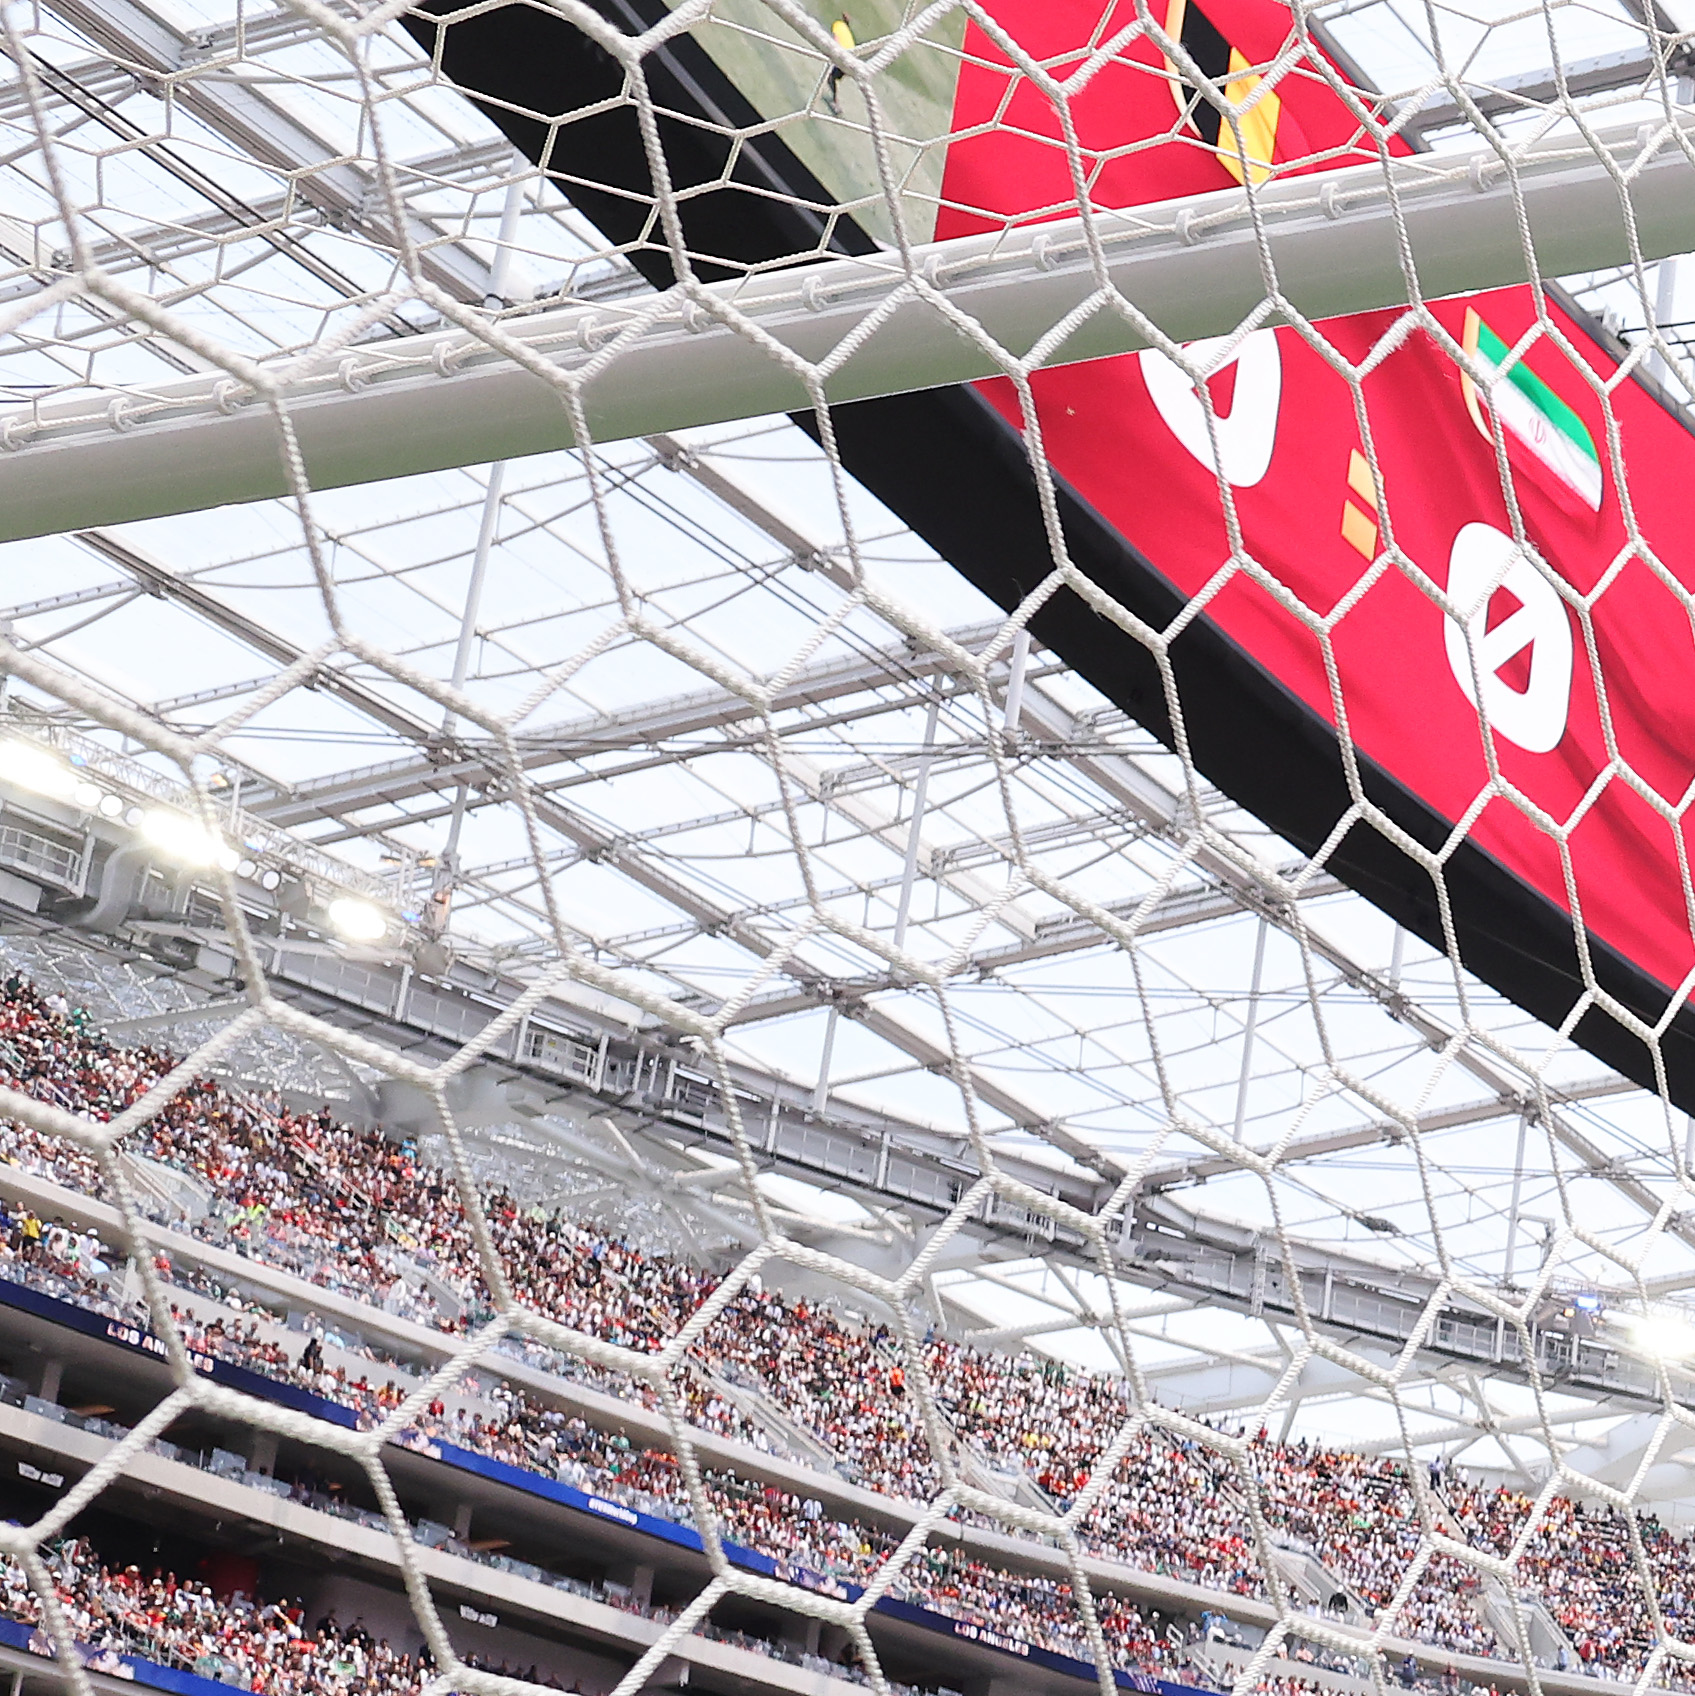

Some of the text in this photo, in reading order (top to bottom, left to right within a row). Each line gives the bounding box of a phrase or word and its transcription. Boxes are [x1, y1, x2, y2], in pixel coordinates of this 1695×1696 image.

[107, 1322, 214, 1373] LOS ANLES
[954, 1621, 1029, 1657] LOS ANGELES
